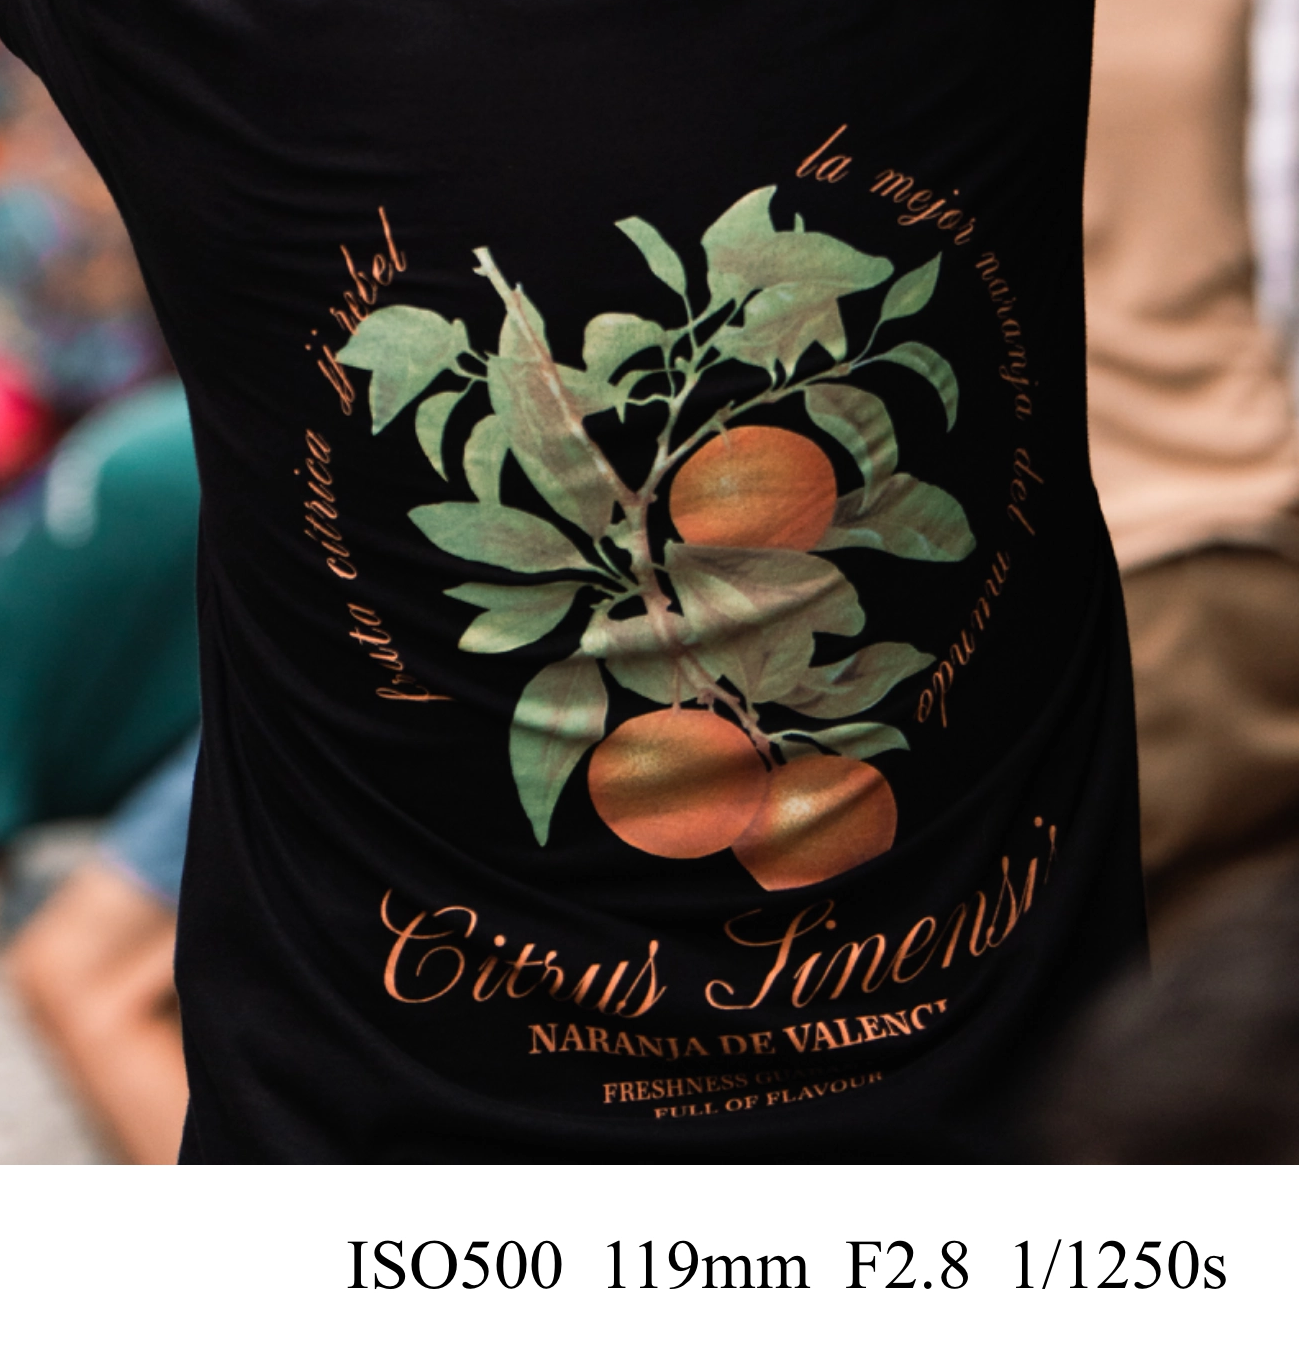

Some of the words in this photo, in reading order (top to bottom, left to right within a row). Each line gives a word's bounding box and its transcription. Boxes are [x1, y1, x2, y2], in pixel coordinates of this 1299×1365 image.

[796, 123, 853, 185] la
[869, 168, 979, 247] mejor
[330, 206, 408, 334] rebel
[975, 252, 1035, 421] naranja
[1006, 447, 1044, 536] del
[347, 602, 453, 703] fruta
[916, 552, 1012, 730] mundo
[380, 889, 669, 1019] Citrus
[528, 1023, 706, 1062] NARANJA
[720, 1031, 777, 1058] DE
[602, 1070, 749, 1106] FRESHNESS
[652, 1104, 720, 1120] FULL
[724, 1095, 761, 1113] OF
[765, 1070, 885, 1107] FLAVOUR
